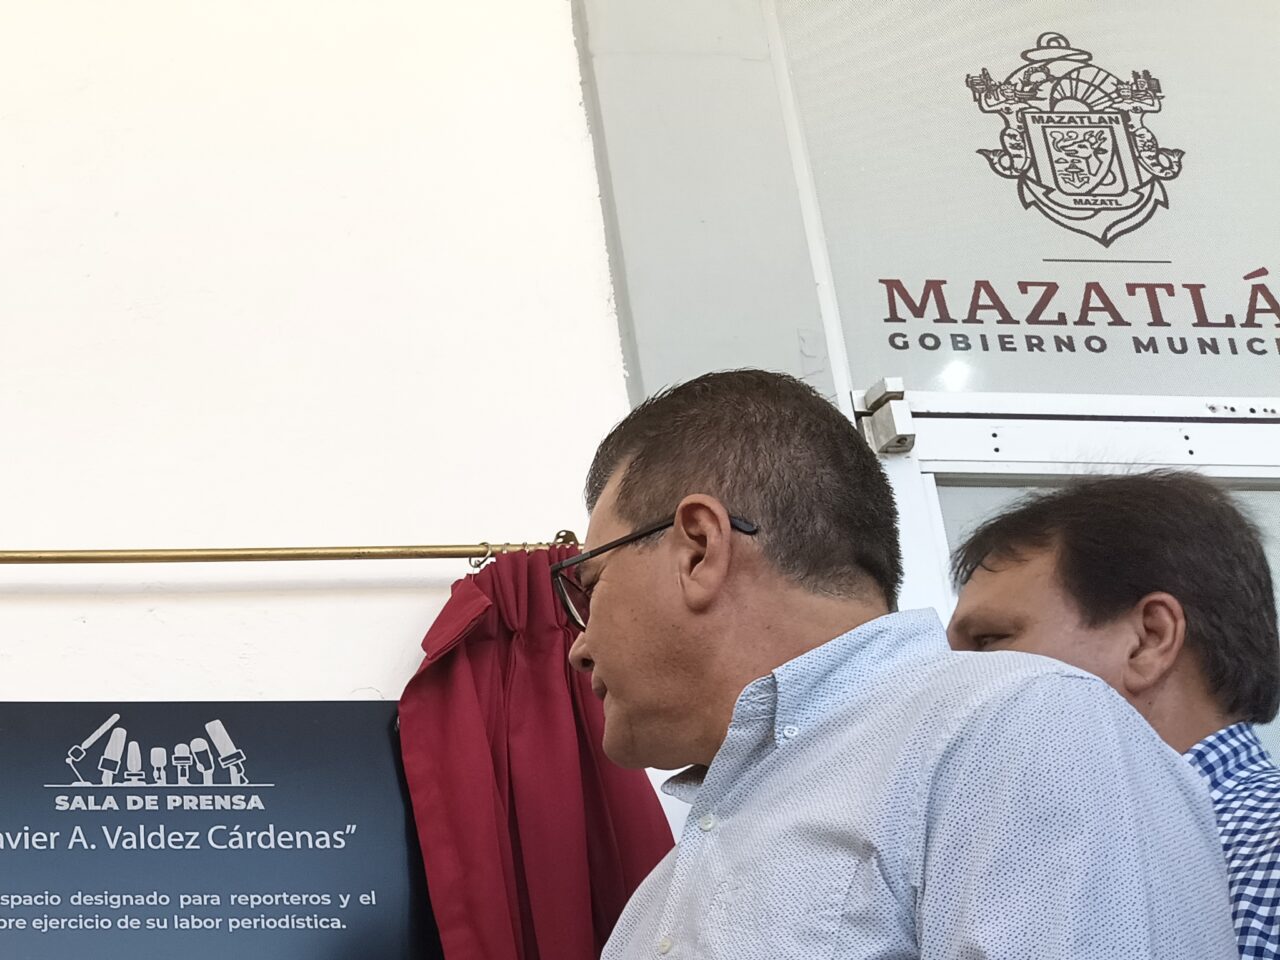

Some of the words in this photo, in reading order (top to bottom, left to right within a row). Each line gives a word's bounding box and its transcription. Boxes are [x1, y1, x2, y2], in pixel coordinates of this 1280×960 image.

[1030, 114, 1121, 126] MAZATLAN
[878, 266, 1280, 329] MAZATLÁ
[888, 332, 1108, 354] GOBIERNO
[55, 795, 120, 811] SALA
[126, 795, 159, 811] DE
[167, 794, 266, 811] PRENSA
[67, 825, 97, 850] A.
[101, 824, 201, 850] Valdez
[69, 890, 171, 909] designado
[179, 894, 221, 909] para
[230, 891, 332, 909] reporteros
[338, 893, 351, 909] y
[358, 890, 377, 906] el
[31, 913, 112, 933] ejercicio
[116, 914, 142, 930] de
[145, 917, 168, 930] su
[173, 914, 223, 930] labor
[228, 913, 347, 933] periodística.
